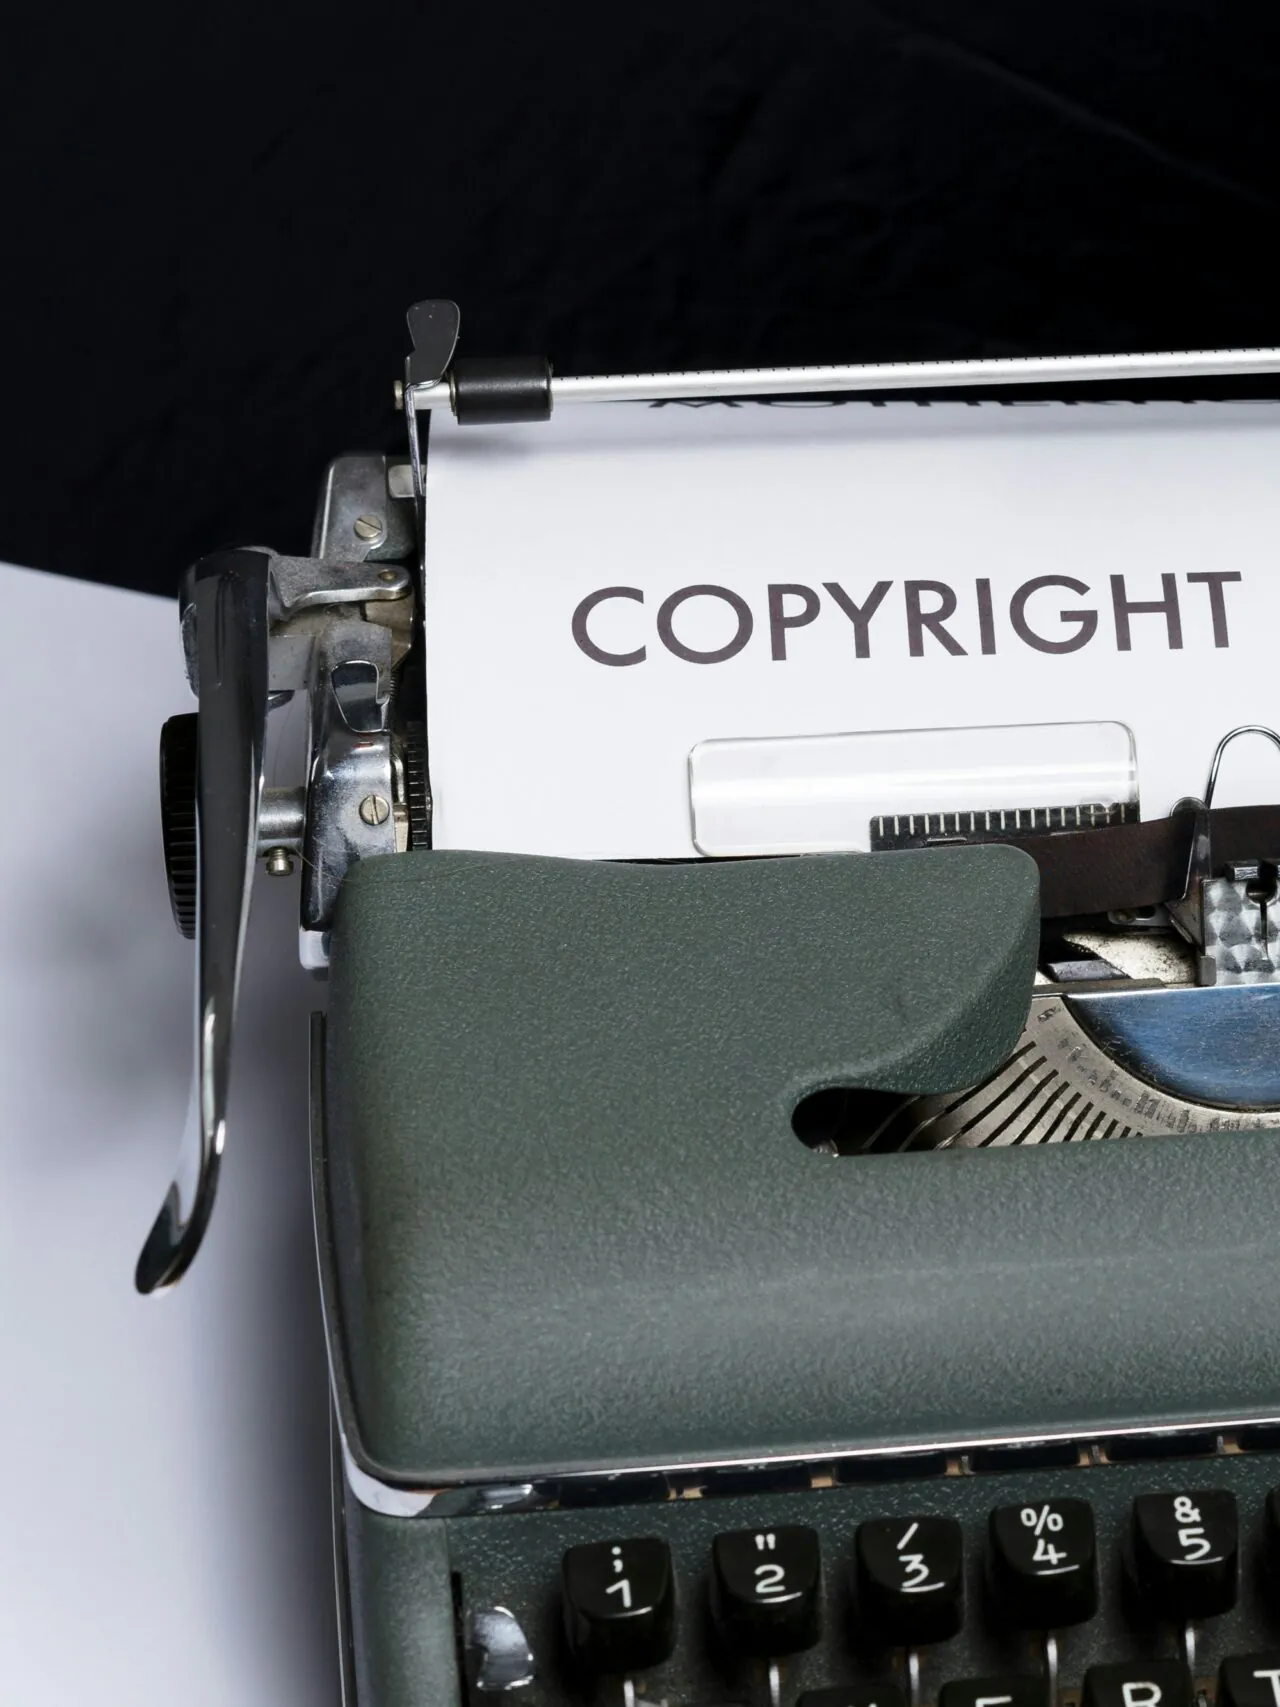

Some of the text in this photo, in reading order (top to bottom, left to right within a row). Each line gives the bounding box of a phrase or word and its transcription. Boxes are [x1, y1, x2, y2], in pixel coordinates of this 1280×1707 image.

[571, 571, 1243, 667] COPYRIGHT
[1020, 1504, 1064, 1536] %
[1172, 1496, 1202, 1523] &
[1031, 1538, 1068, 1566] 4
[1177, 1527, 1212, 1561] 5
[754, 1564, 786, 1594] 2
[898, 1553, 930, 1589] 3
[605, 1578, 632, 1609] 1
